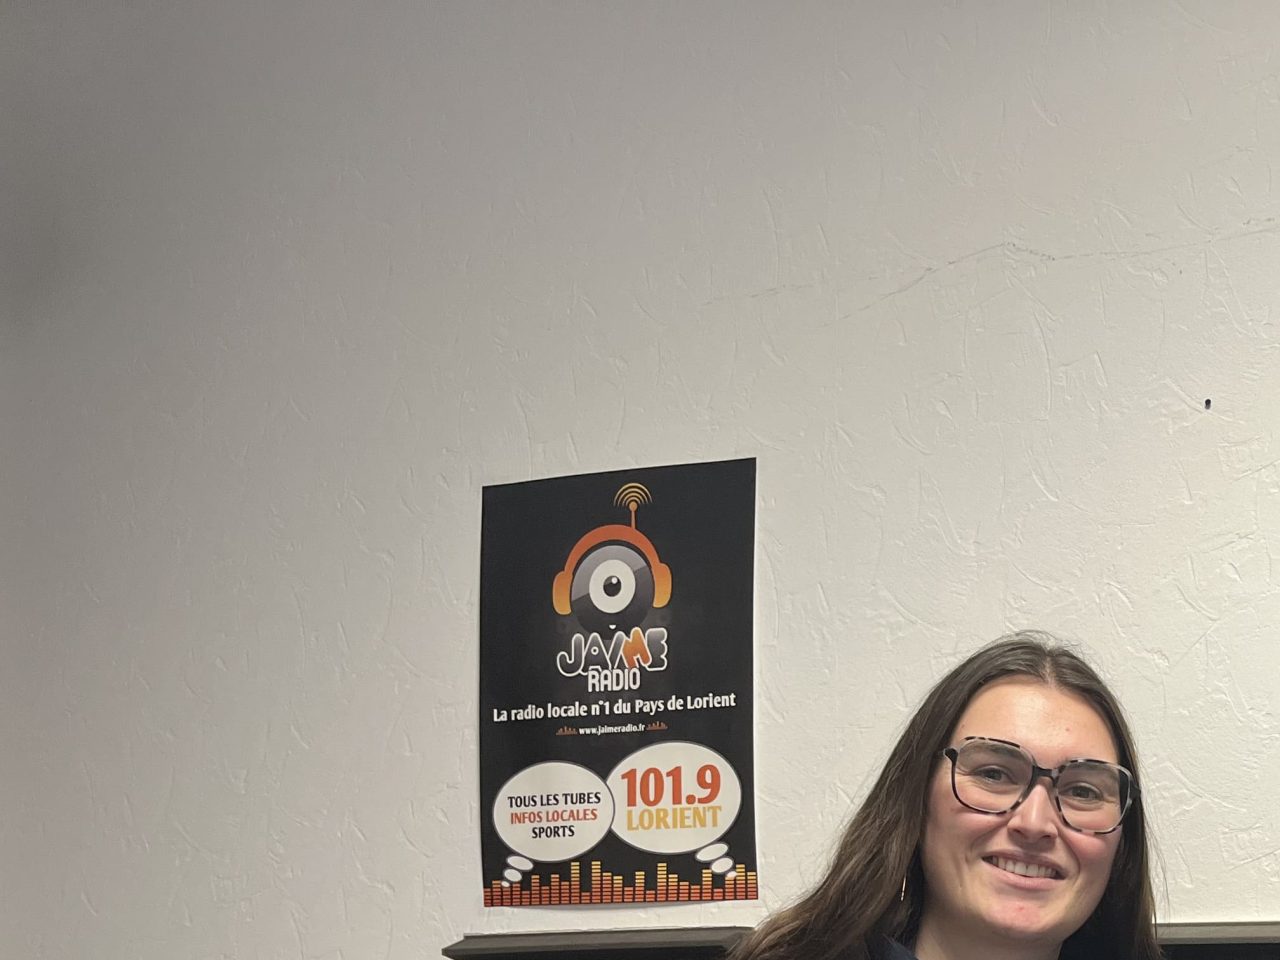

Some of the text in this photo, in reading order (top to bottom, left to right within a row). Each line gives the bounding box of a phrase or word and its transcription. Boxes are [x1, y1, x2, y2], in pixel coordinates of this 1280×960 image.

[587, 665, 641, 693] RADIO
[493, 708, 508, 722] La
[511, 704, 544, 721] radio
[547, 701, 588, 718] locale
[614, 699, 631, 715] du
[635, 698, 664, 717] Pays
[667, 695, 684, 711] de
[686, 692, 736, 710] Lorient
[578, 724, 645, 735] www.jaimeradio.fr
[620, 764, 721, 807] 101.9
[507, 792, 601, 808] TOUS LES TUBES
[510, 809, 598, 825] INFOS LOCALES
[626, 806, 722, 831] LORIENT
[531, 826, 575, 839] SPORTS
